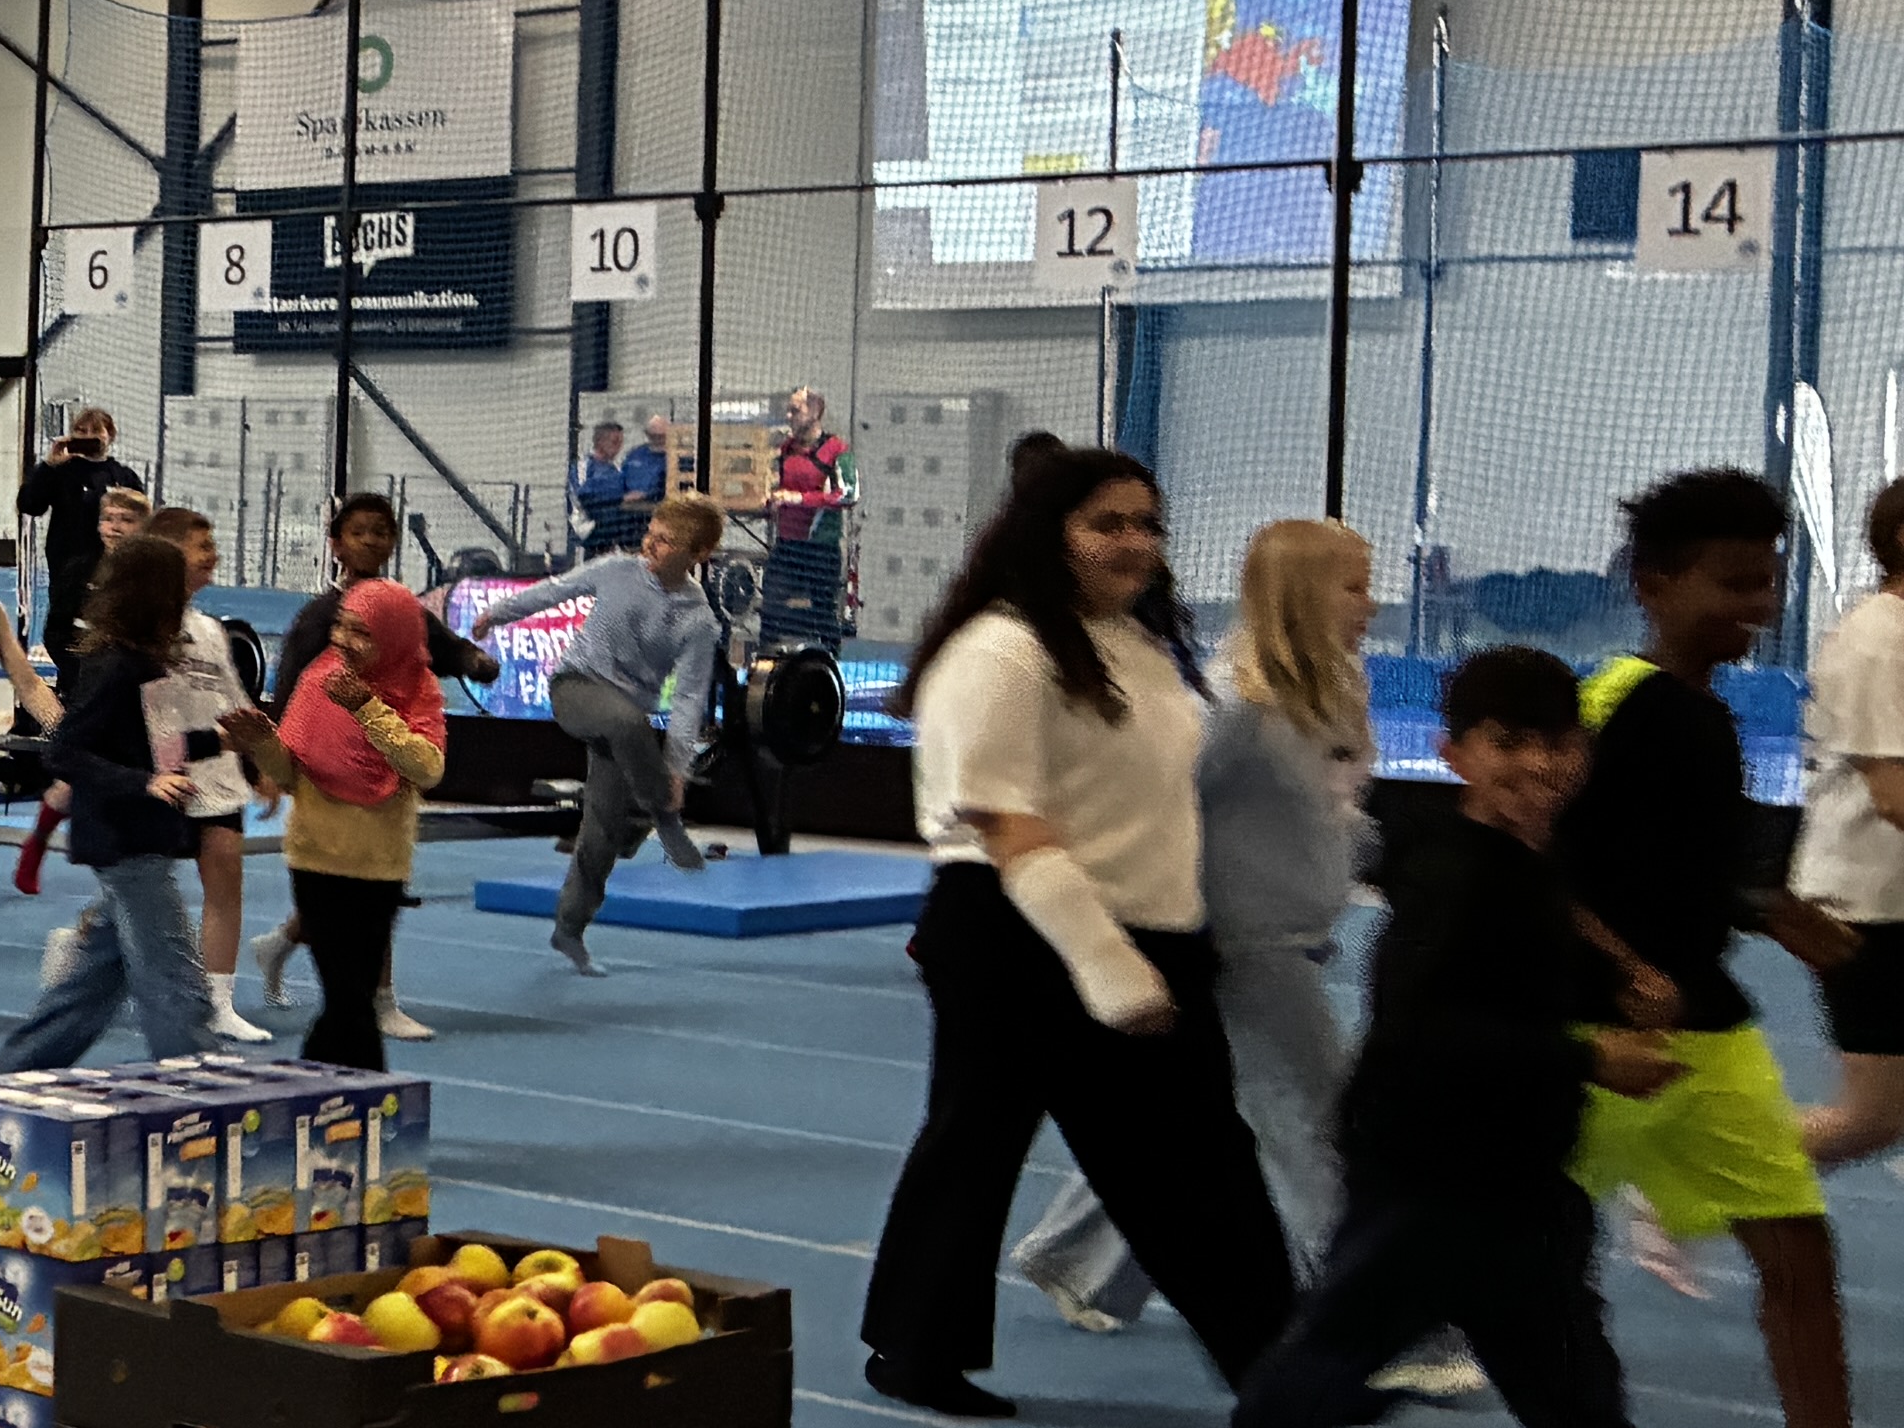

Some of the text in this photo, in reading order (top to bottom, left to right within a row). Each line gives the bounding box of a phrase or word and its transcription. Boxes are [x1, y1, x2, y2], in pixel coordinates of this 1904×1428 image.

[297, 108, 446, 143] Spakassen
[1666, 178, 1745, 236] 14
[590, 227, 639, 273] 10
[1056, 207, 1115, 257] 12
[87, 249, 109, 290] 6
[224, 244, 245, 285] 8
